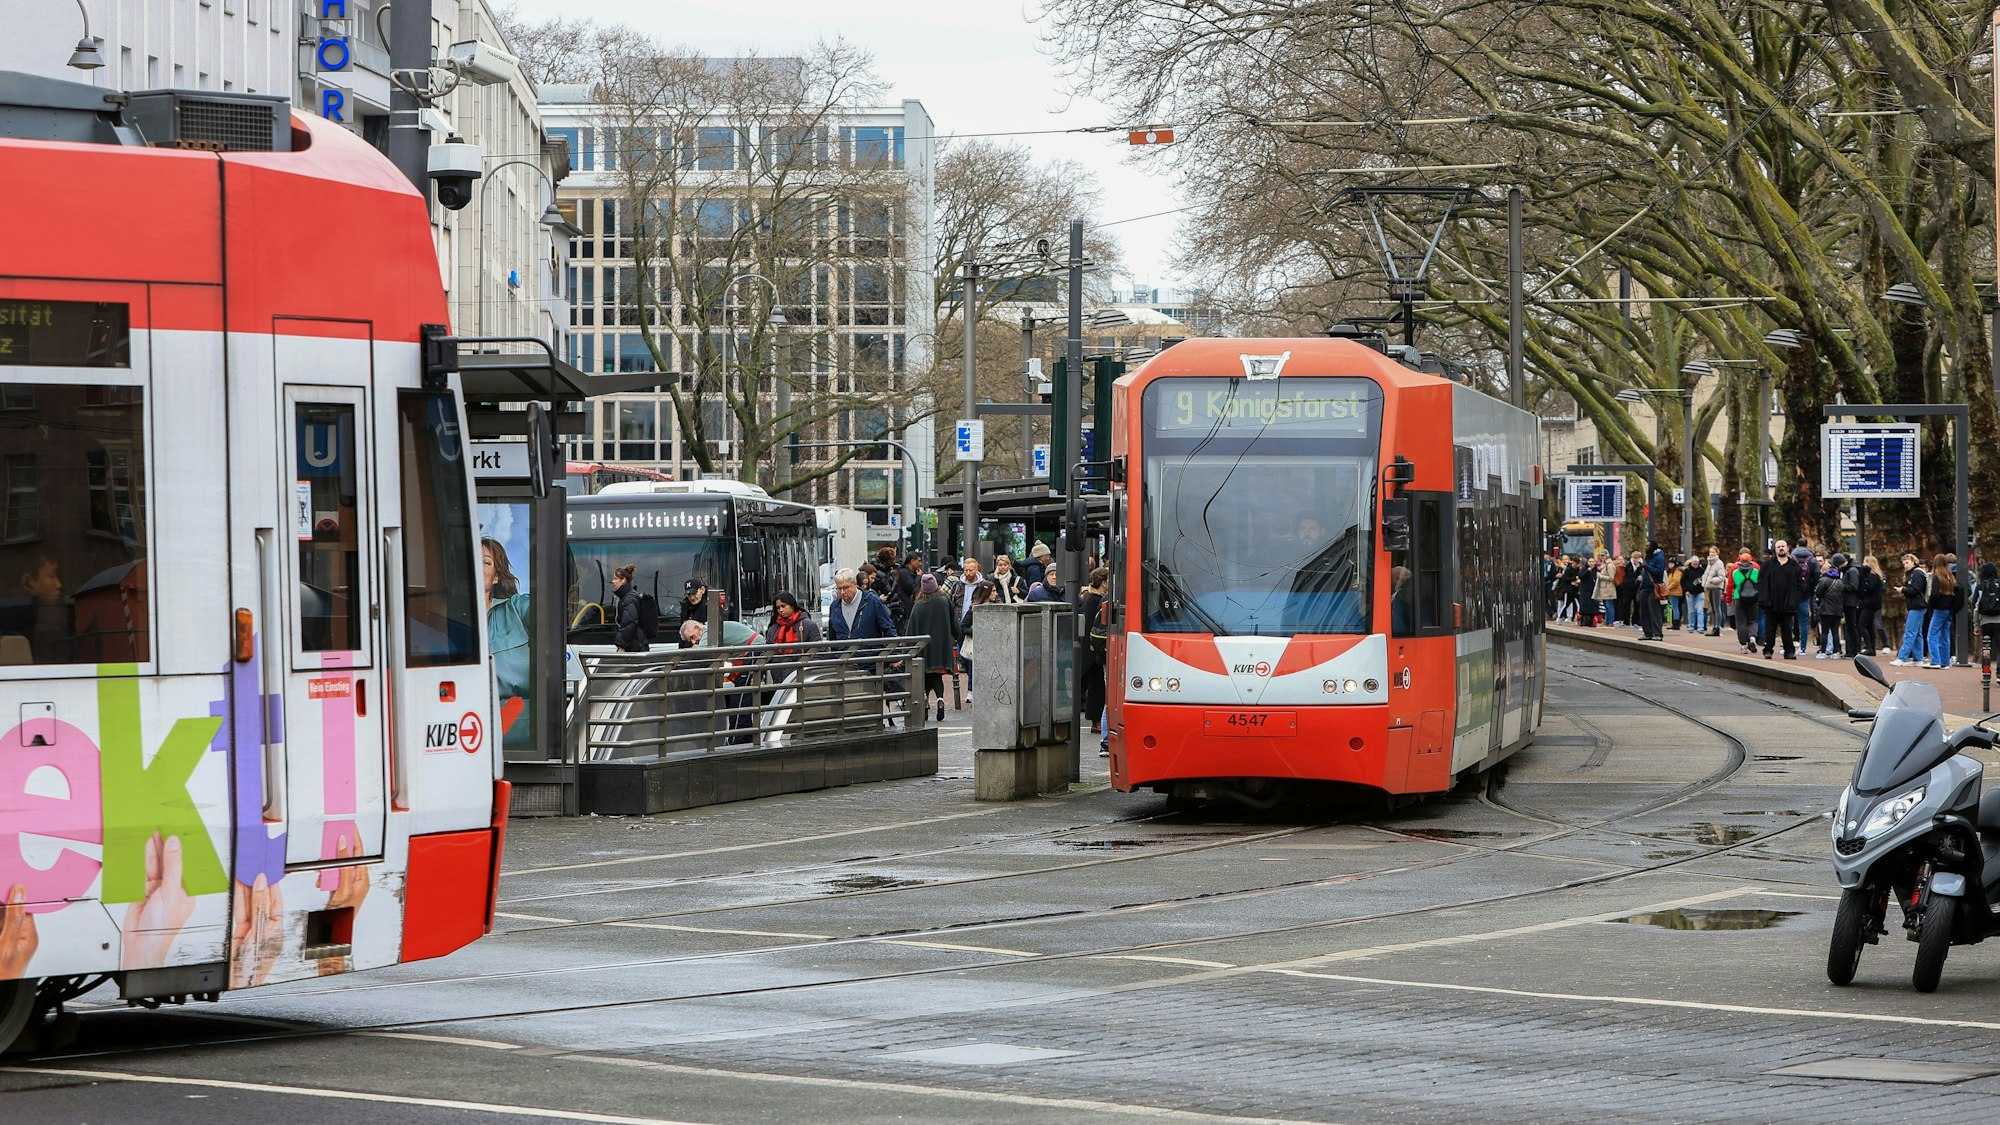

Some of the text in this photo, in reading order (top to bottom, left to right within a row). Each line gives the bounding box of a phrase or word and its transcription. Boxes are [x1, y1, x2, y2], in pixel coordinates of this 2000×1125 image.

[1178, 391, 1360, 425] 9 Königsforst
[305, 425, 336, 467] U
[473, 451, 501, 469] rkt
[1675, 493, 1682, 501] 4
[1233, 664, 1255, 673] KVB
[309, 681, 350, 693] Kein Einstieg
[1228, 714, 1268, 726] 4547
[426, 723, 458, 748] KVB
